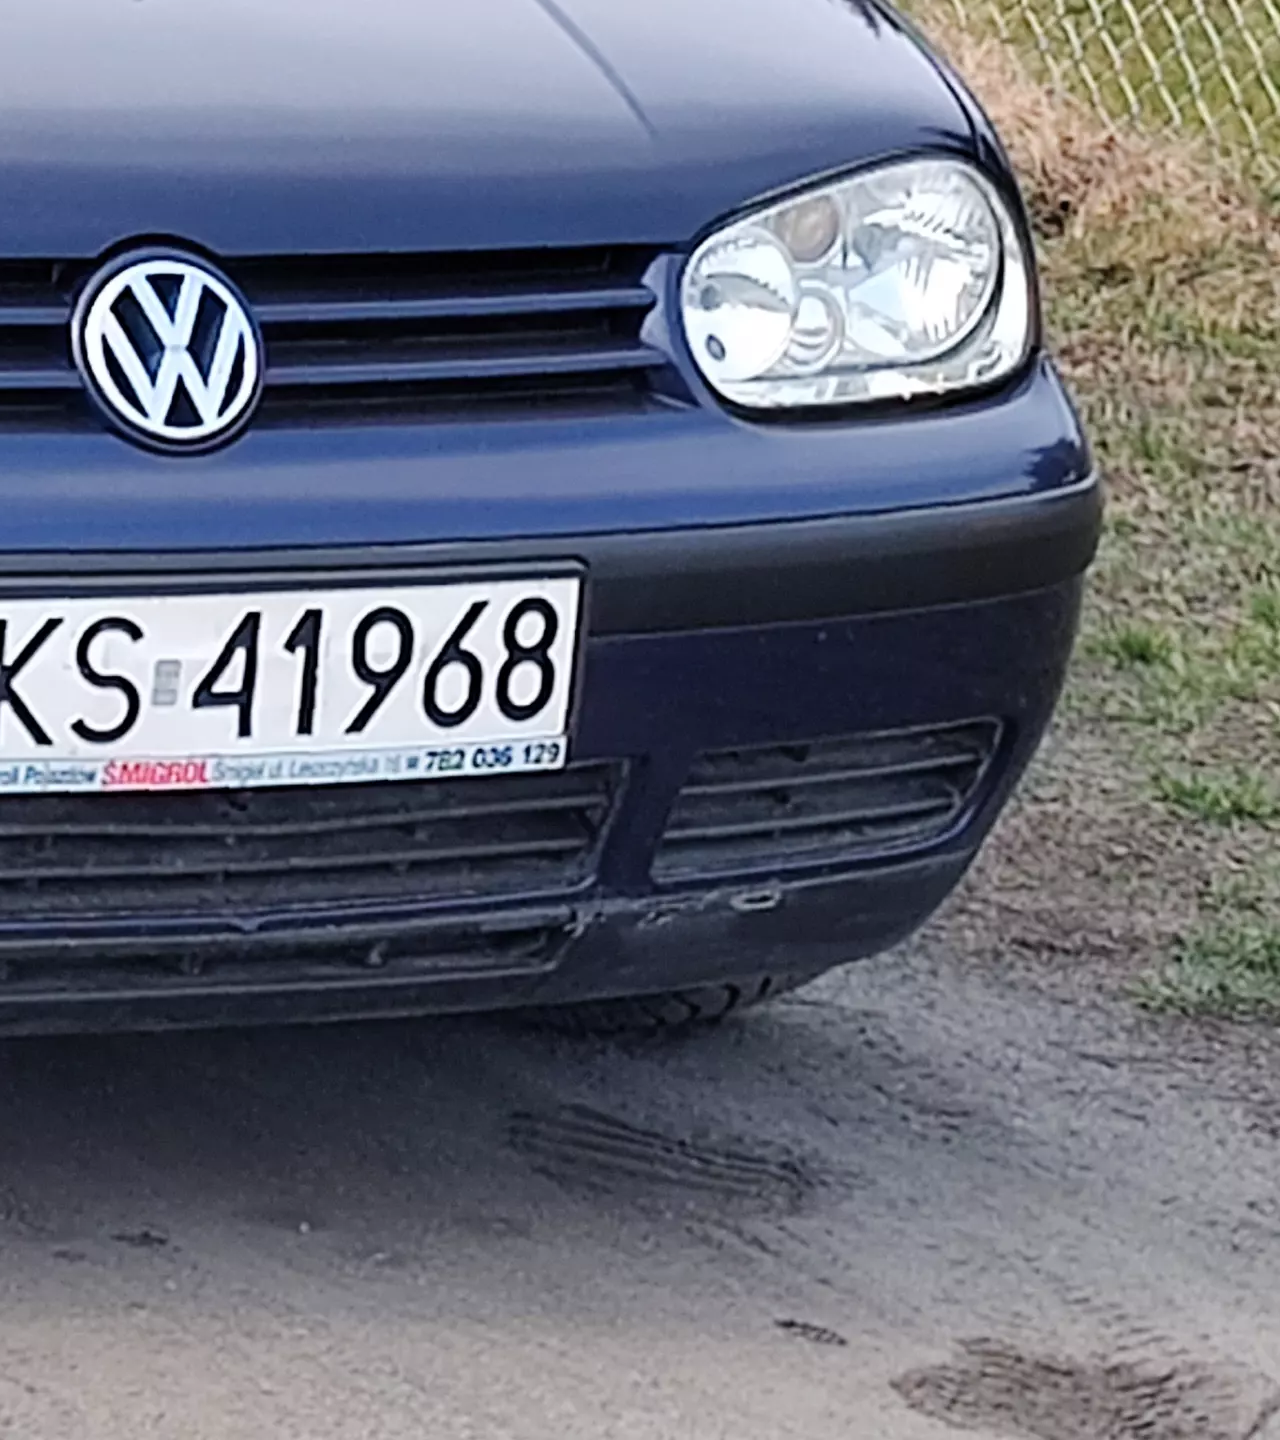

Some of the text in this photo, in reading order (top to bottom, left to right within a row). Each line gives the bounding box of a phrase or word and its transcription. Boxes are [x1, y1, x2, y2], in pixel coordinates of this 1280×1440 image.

[85, 259, 258, 440] VW
[191, 596, 559, 737] 41968
[523, 742, 560, 766] 129
